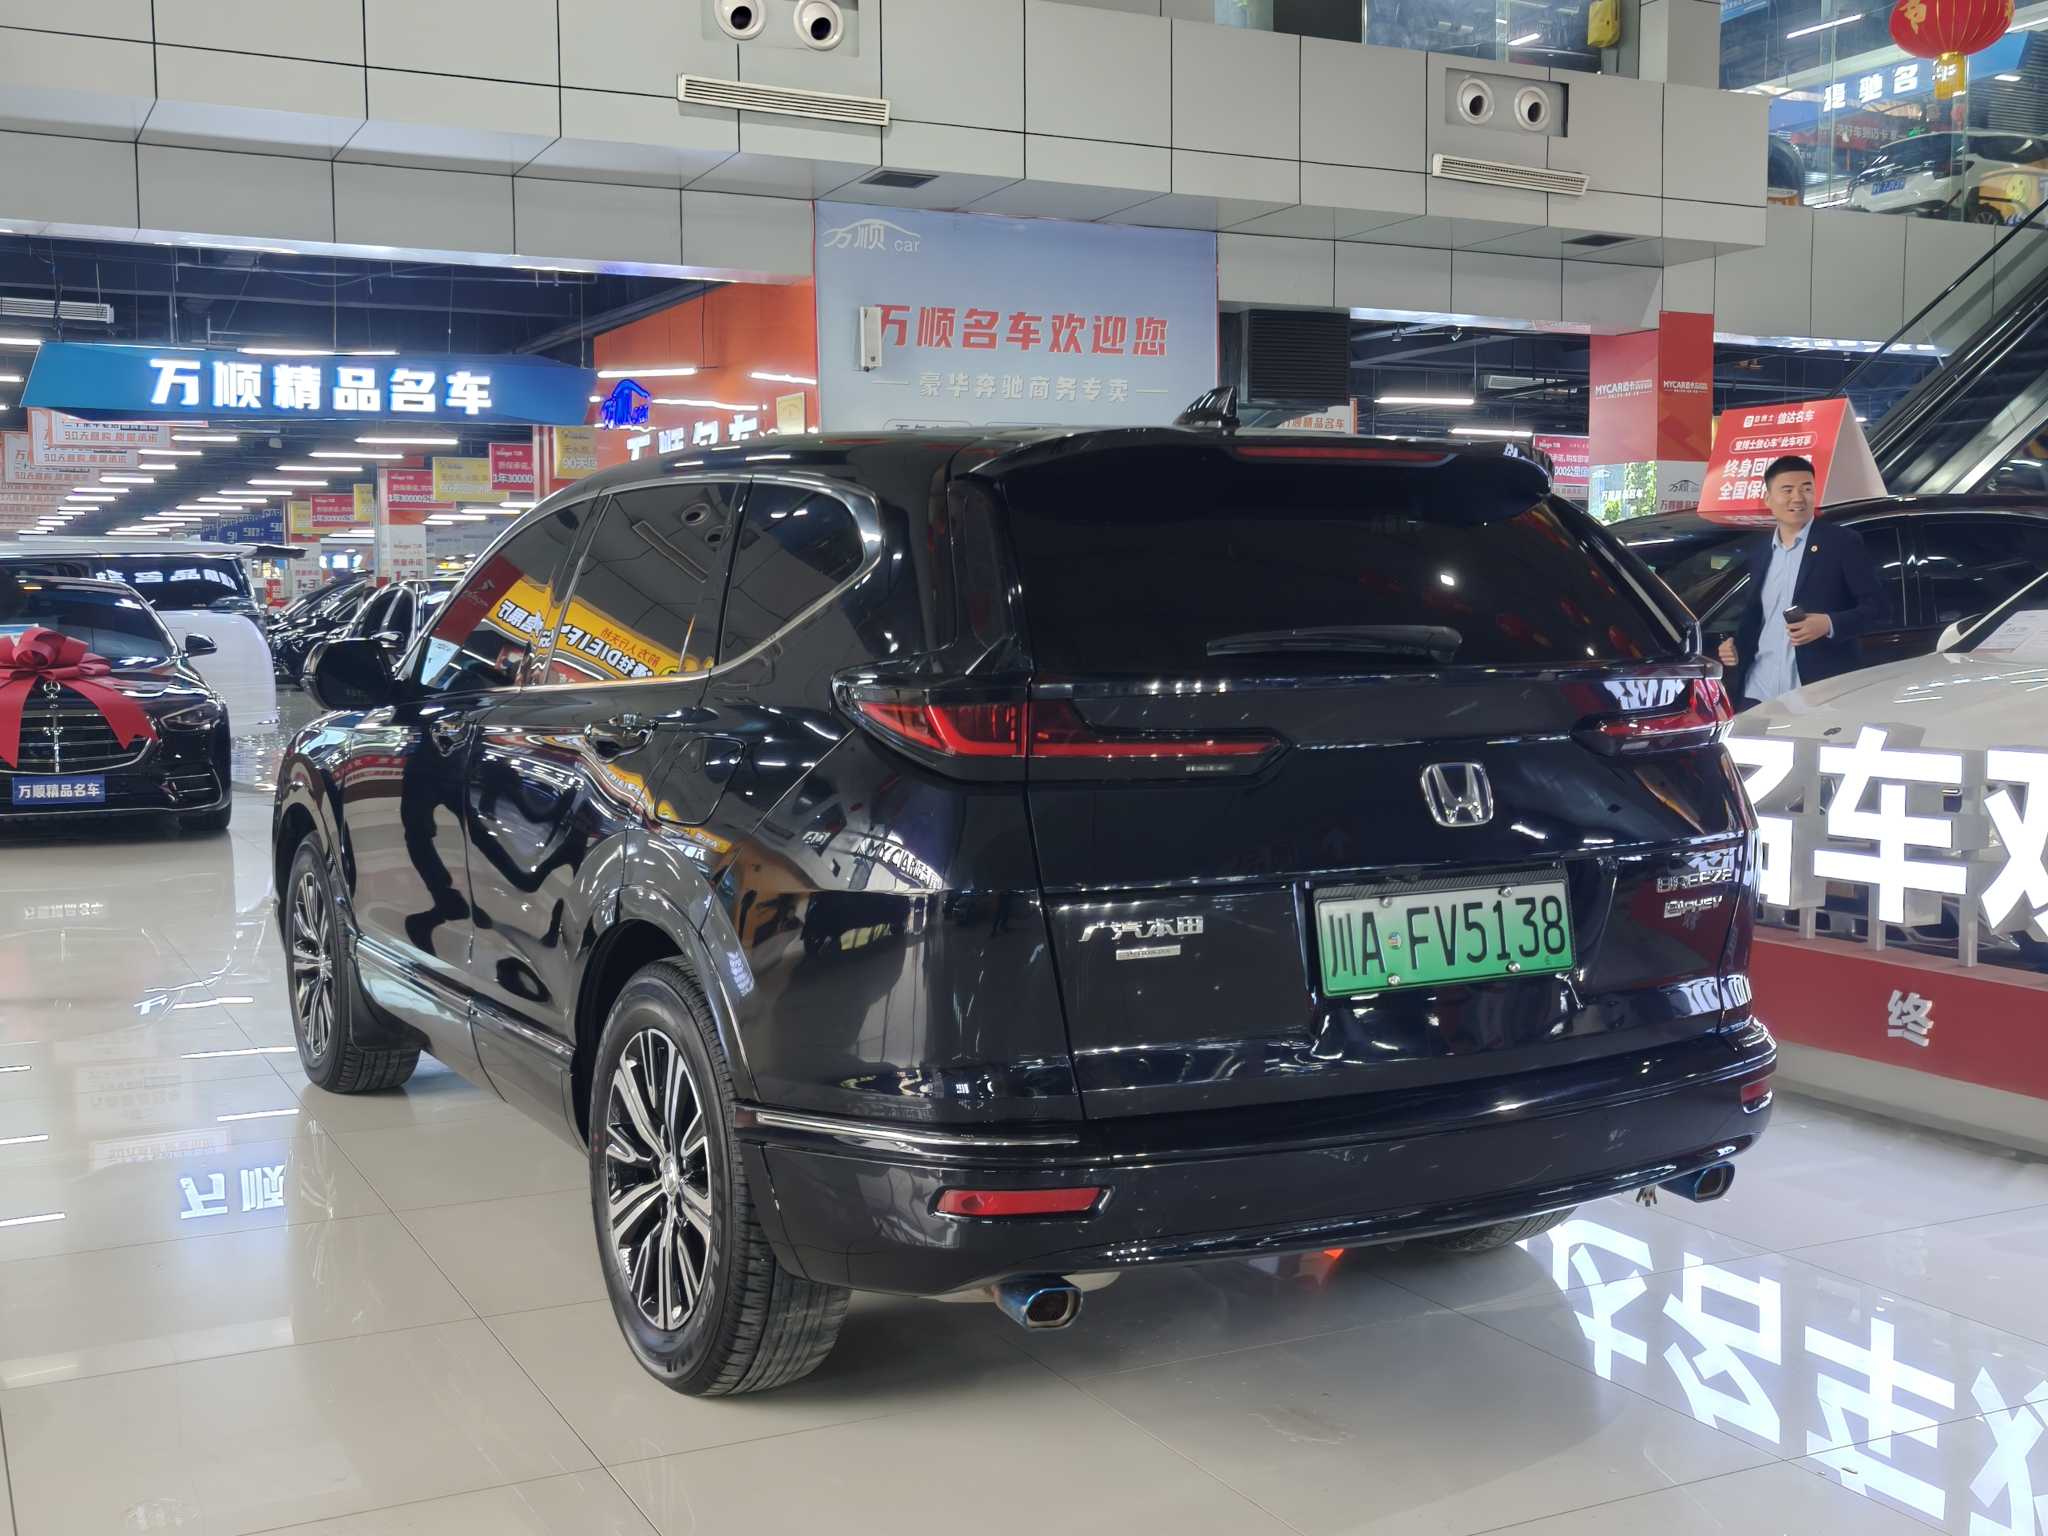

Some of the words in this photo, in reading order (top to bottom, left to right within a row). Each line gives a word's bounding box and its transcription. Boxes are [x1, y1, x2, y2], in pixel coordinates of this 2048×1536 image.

[824, 221, 886, 250] 万顺
[894, 237, 920, 252] car
[874, 302, 1169, 356] 万顺名车欢迎您
[149, 359, 493, 416] 万顺精品名车
[18, 781, 101, 799] 万顺精品名车
[1078, 915, 1204, 943] 广汽本田
[1327, 911, 1386, 979] 川A
[1406, 895, 1567, 971] FV5138
[1887, 989, 1933, 1047] 终
